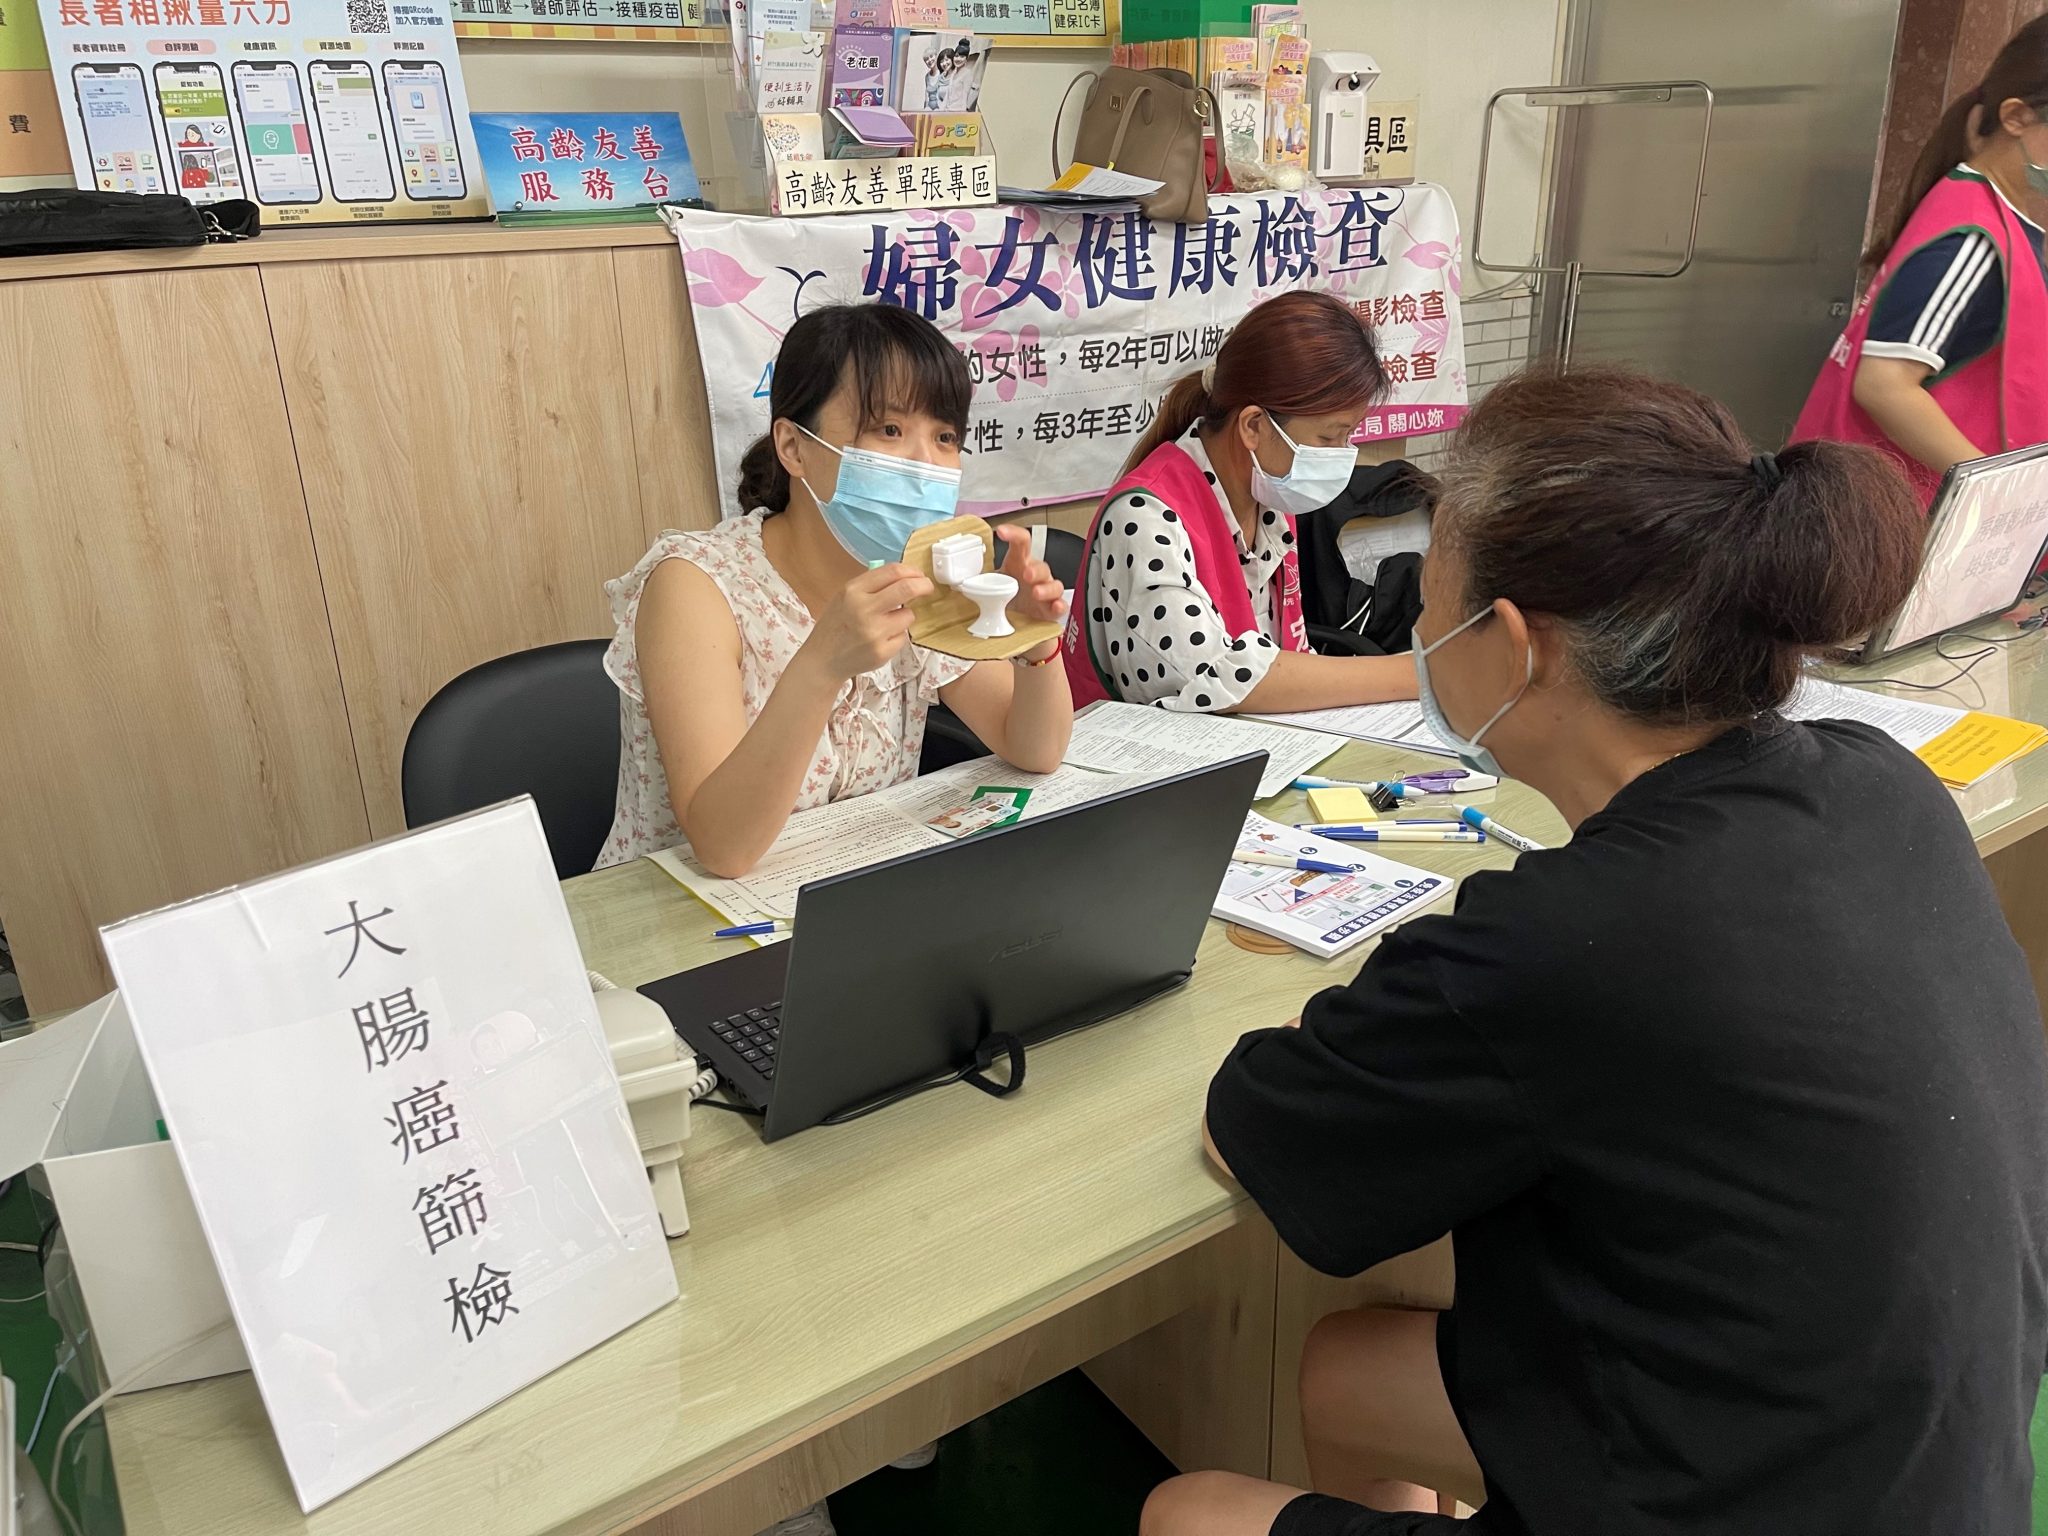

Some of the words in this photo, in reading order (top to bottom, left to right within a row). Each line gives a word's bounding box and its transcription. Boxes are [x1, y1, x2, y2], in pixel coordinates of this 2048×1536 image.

[530, 0, 598, 17] 醫師評估
[615, 0, 679, 20] 接種疫苗
[959, 2, 1011, 19] 批價繳費
[1023, 4, 1048, 20] 取件
[395, 16, 445, 27] 加入官方帳號
[1054, 14, 1101, 29] 健保IC卡
[72, 42, 127, 54] 長者資料註冊
[164, 42, 200, 53] 自評測驗
[243, 41, 278, 52] 健康資訊
[319, 41, 352, 51] 資源地圖
[846, 56, 880, 69] 老花眼
[8, 114, 32, 134] 費
[510, 124, 665, 163] 高齡友善
[520, 166, 673, 203] 服務台
[785, 163, 993, 209] 高齡友善單張專區
[862, 188, 1402, 321] 婦女健康檢查
[1387, 407, 1445, 434] 關心妳
[324, 900, 521, 1344] 大腸癌篩檢
